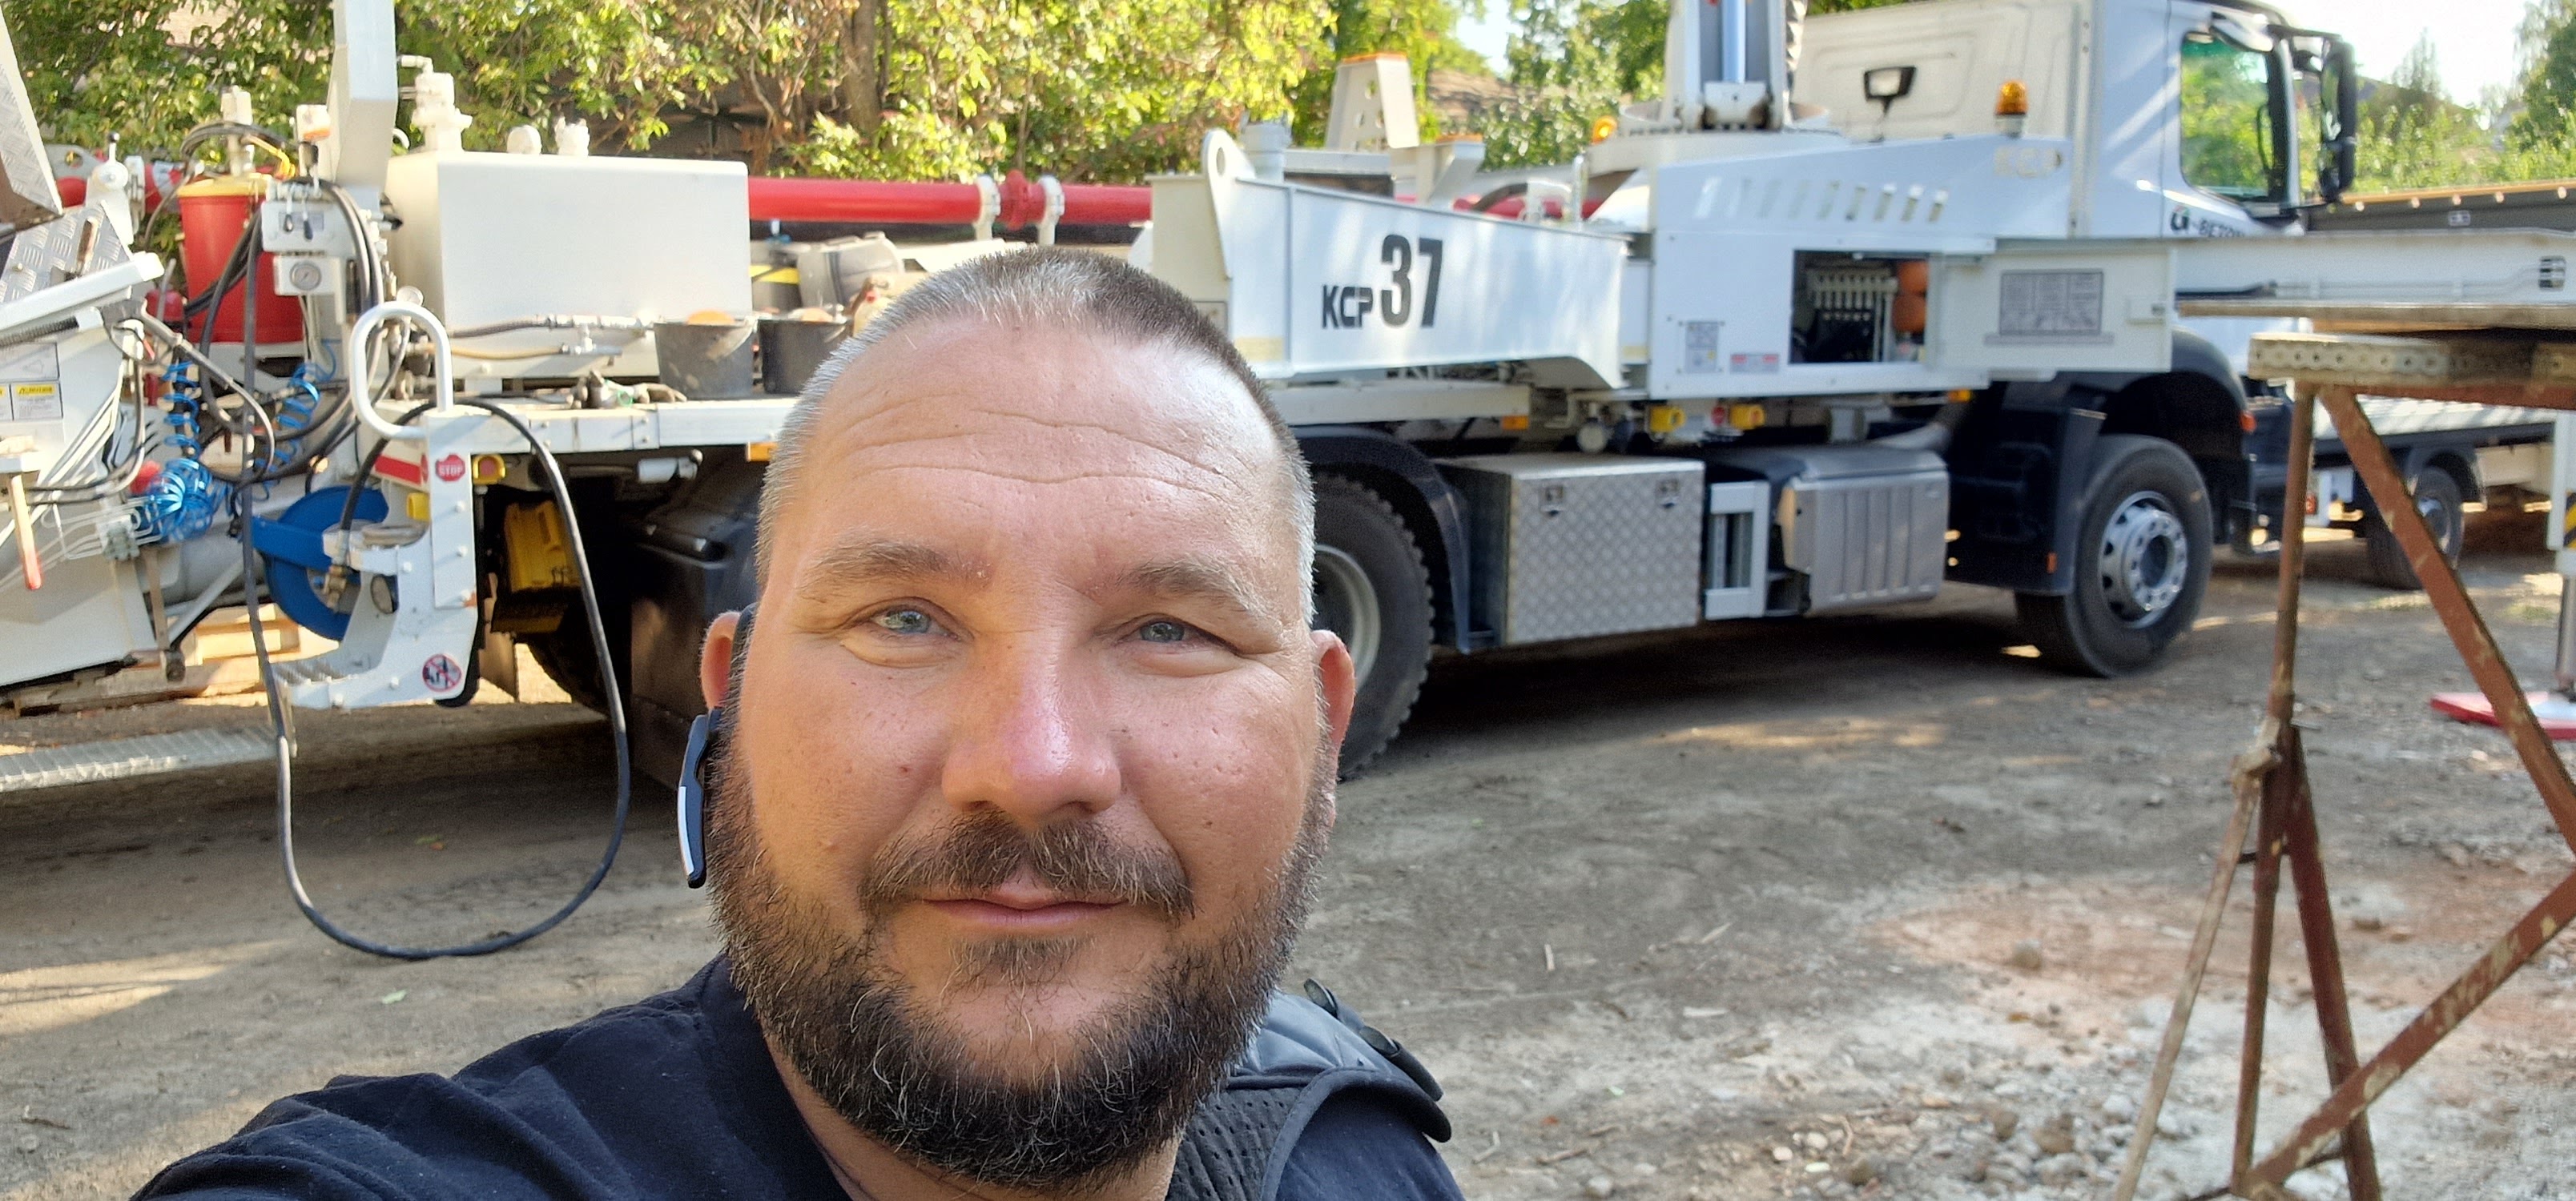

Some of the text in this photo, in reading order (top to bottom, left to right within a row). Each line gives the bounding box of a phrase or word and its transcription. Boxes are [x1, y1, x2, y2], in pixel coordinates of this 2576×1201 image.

[1322, 234, 1443, 329] KCP 37
[438, 464, 463, 477] STOP
